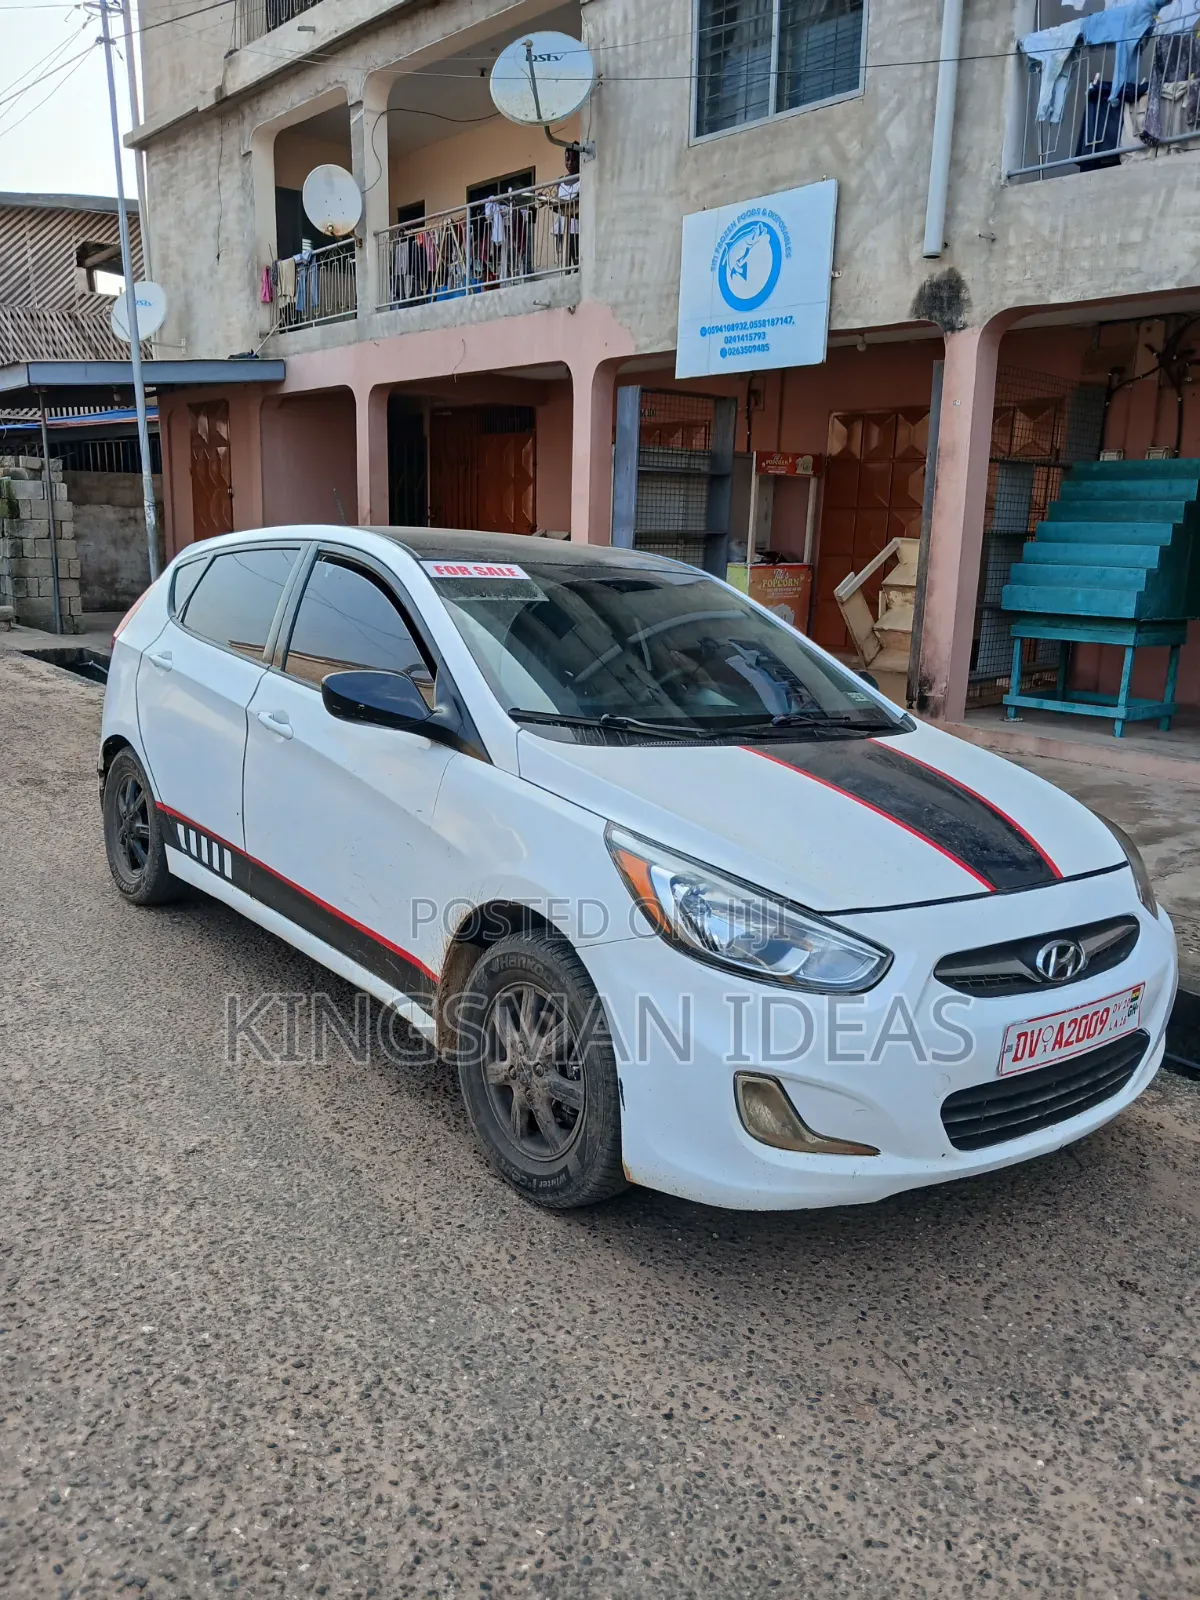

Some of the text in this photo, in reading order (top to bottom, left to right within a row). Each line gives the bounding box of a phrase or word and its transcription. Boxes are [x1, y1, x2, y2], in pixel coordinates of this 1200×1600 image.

[716, 220, 737, 254] FROZEN
[737, 208, 761, 223] FOODS
[761, 208, 767, 216] &
[768, 210, 792, 259] DISPOSABLES
[433, 565, 519, 577] FOR SALE
[762, 578, 800, 588] POPCORN
[1011, 1028, 1042, 1063] DV
[1051, 1007, 1111, 1052] A2009
